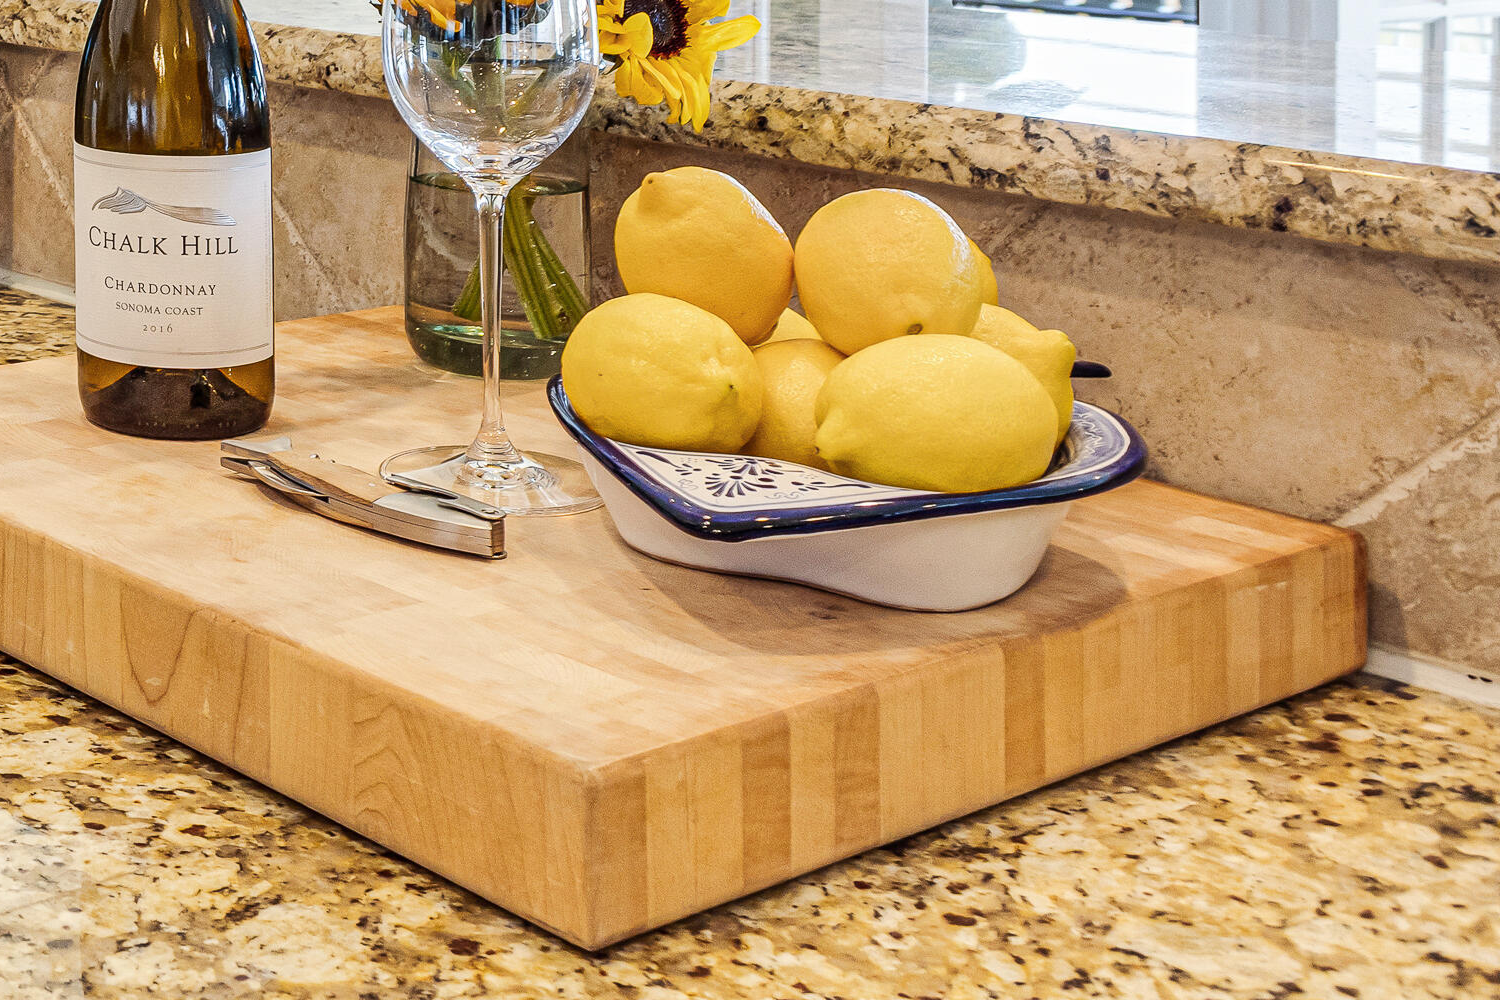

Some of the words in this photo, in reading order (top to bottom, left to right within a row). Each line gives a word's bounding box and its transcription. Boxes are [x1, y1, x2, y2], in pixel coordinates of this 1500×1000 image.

[88, 225, 168, 256] CHALK
[181, 235, 239, 256] HILL
[104, 275, 217, 296] CHARDONNAY
[115, 301, 160, 315] SONOMA
[164, 306, 204, 316] COAST
[142, 323, 173, 334] 2016
